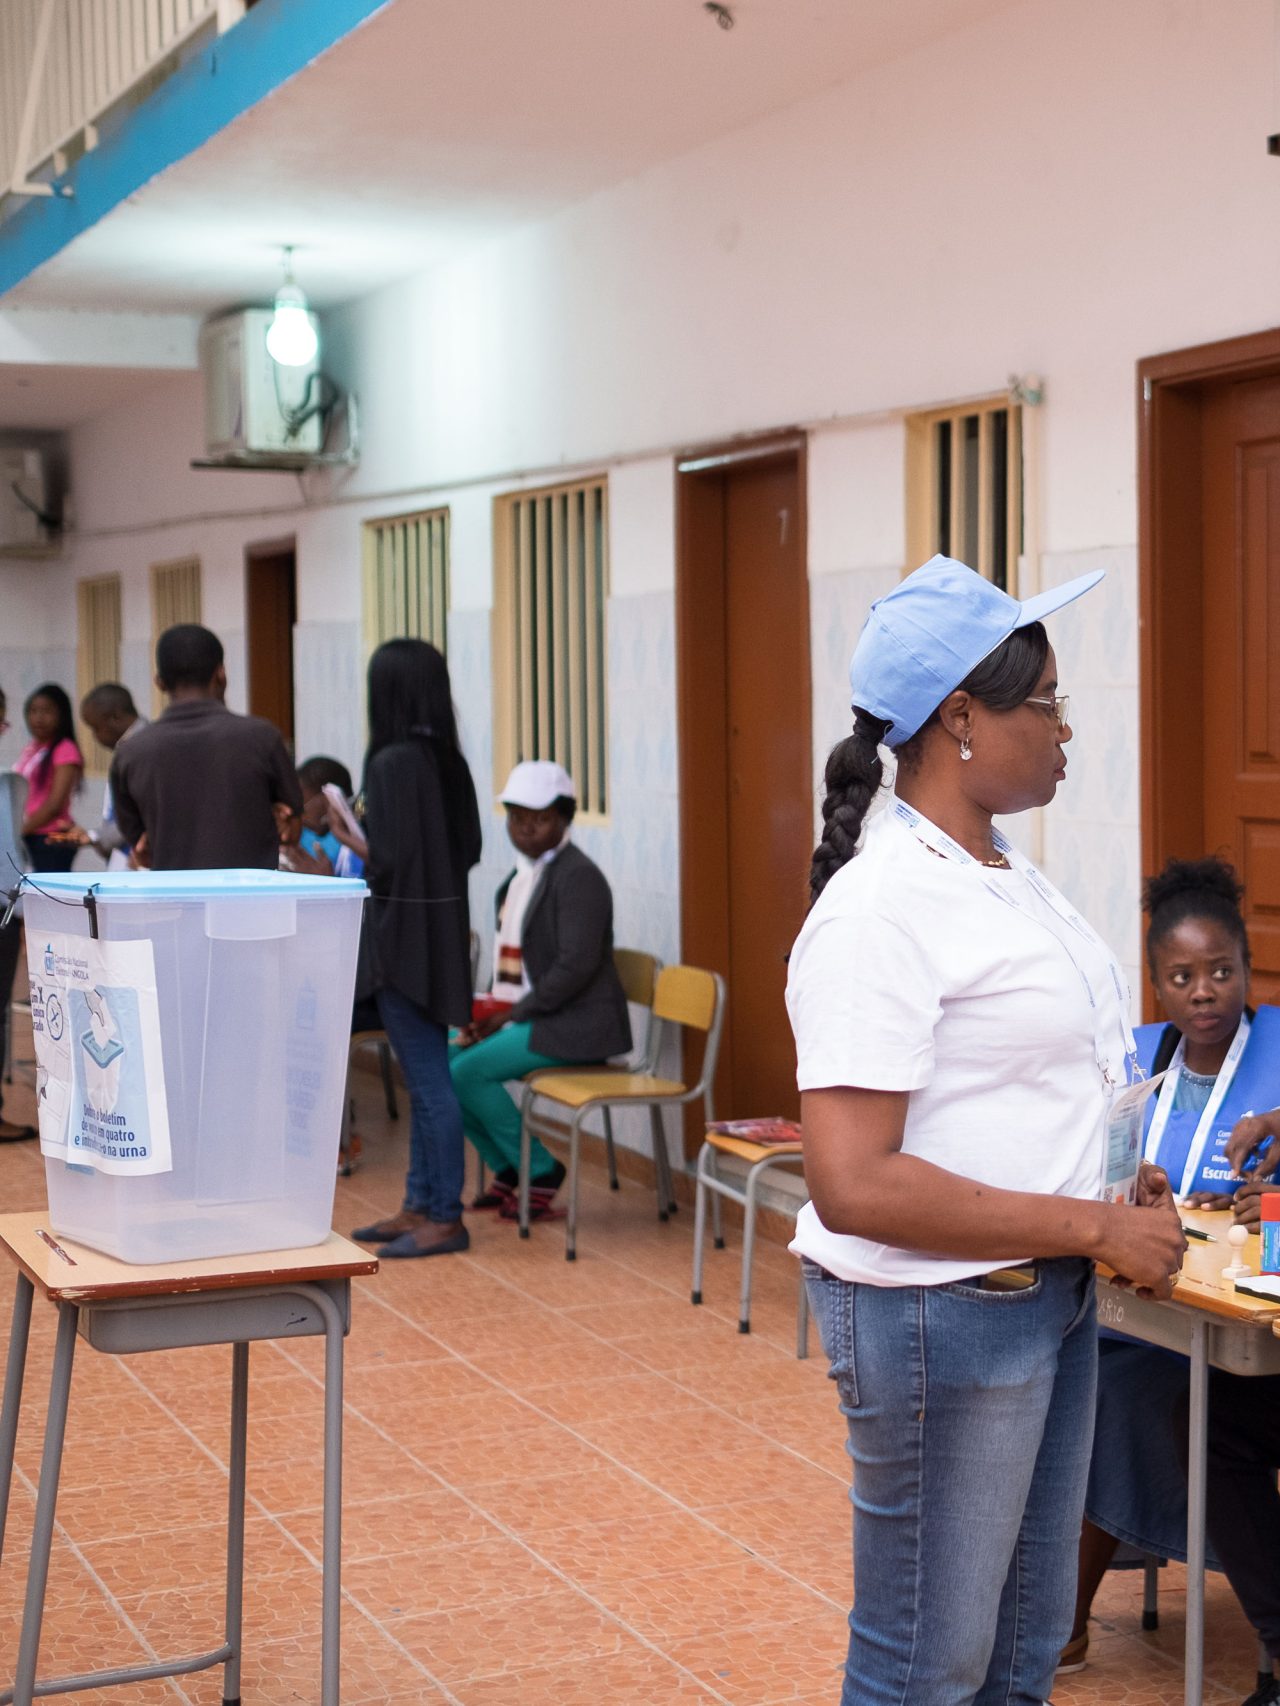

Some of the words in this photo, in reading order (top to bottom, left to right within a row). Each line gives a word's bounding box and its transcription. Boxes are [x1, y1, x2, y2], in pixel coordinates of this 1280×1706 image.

[105, 1129, 135, 1143] quatro
[107, 1145, 116, 1157] na
[119, 1146, 147, 1158] urna
